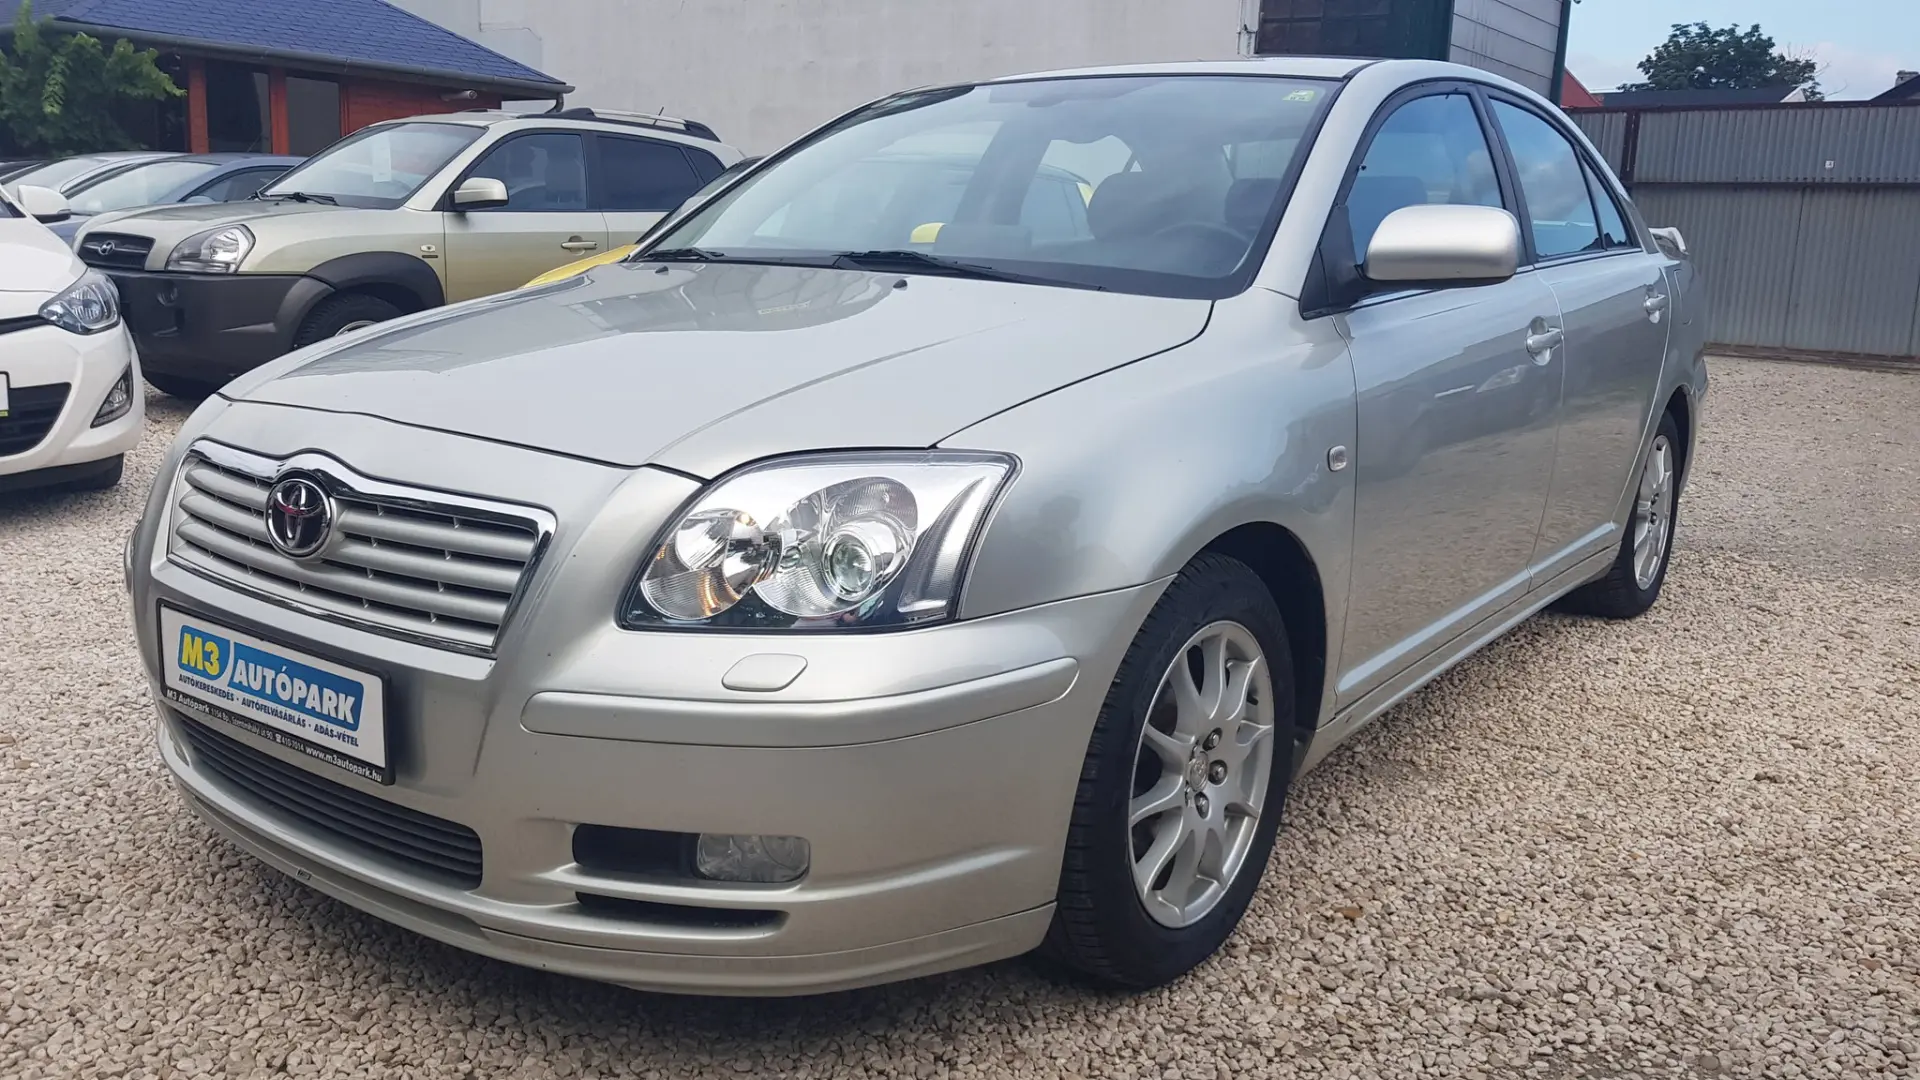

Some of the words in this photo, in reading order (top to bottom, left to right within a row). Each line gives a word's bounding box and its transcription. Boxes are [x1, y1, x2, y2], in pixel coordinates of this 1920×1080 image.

[179, 674, 235, 702] AUTÓKERESKEDÉS
[241, 697, 306, 728] AUTÓFELVÁSÁRLÁS
[314, 723, 359, 747] ADÁS-VÉTEL
[181, 632, 220, 676] M3
[233, 659, 356, 725] AUTÓPARK
[166, 689, 177, 700] M3
[178, 694, 210, 715] Autópark
[305, 746, 382, 782] www.m3autopark.hu
